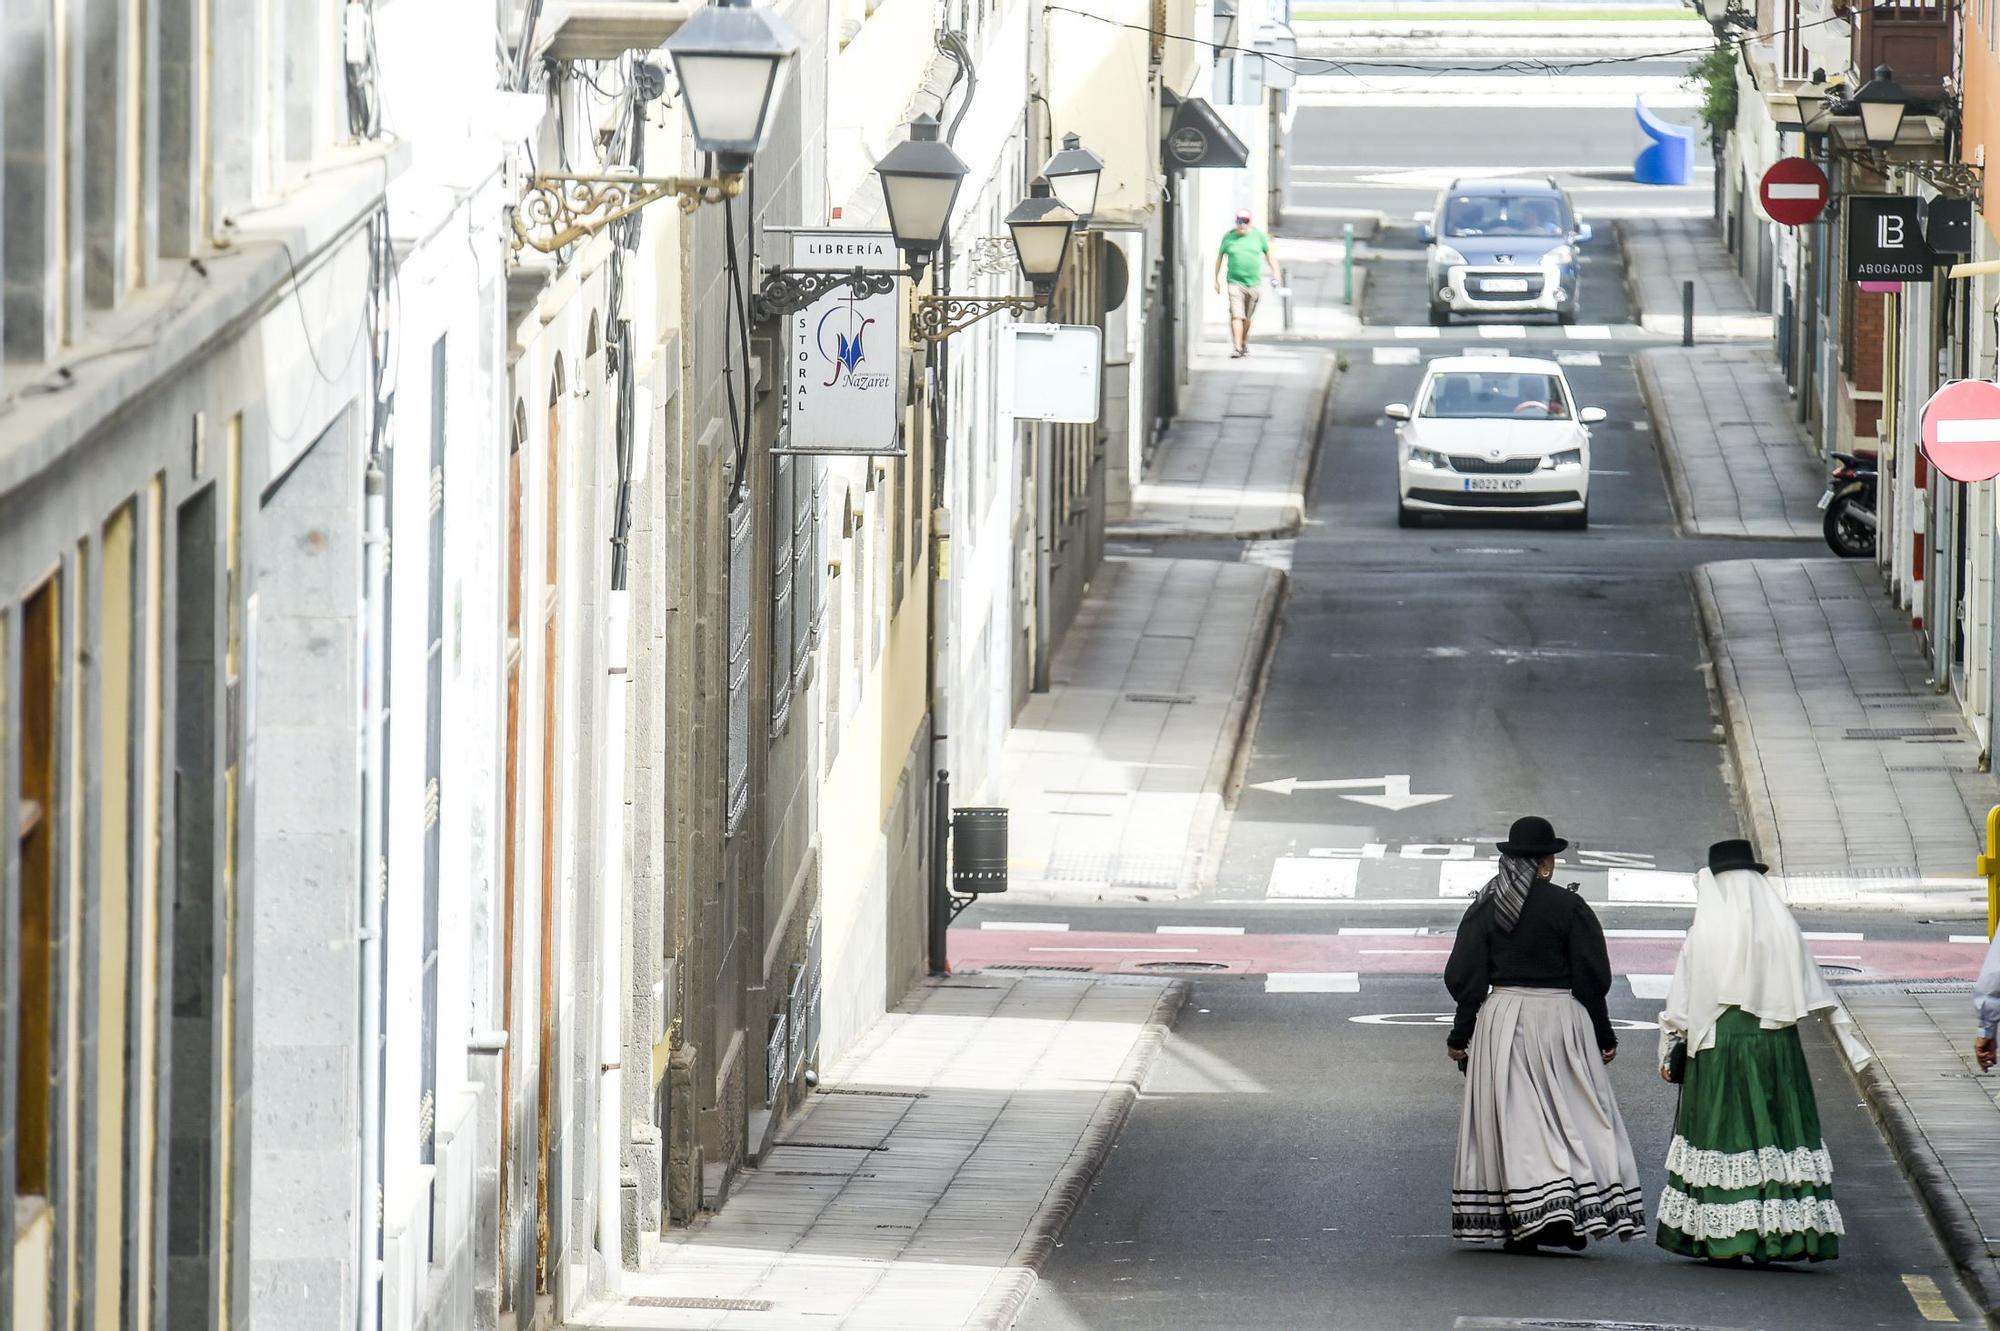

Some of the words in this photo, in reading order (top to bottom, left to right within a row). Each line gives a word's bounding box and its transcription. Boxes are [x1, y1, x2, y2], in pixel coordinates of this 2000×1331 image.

[809, 242, 883, 255] LIBRERÍA
[1858, 263, 1924, 274] ABOGADOS
[842, 373, 889, 391] Nazaret
[1308, 843, 1657, 868] SOP
